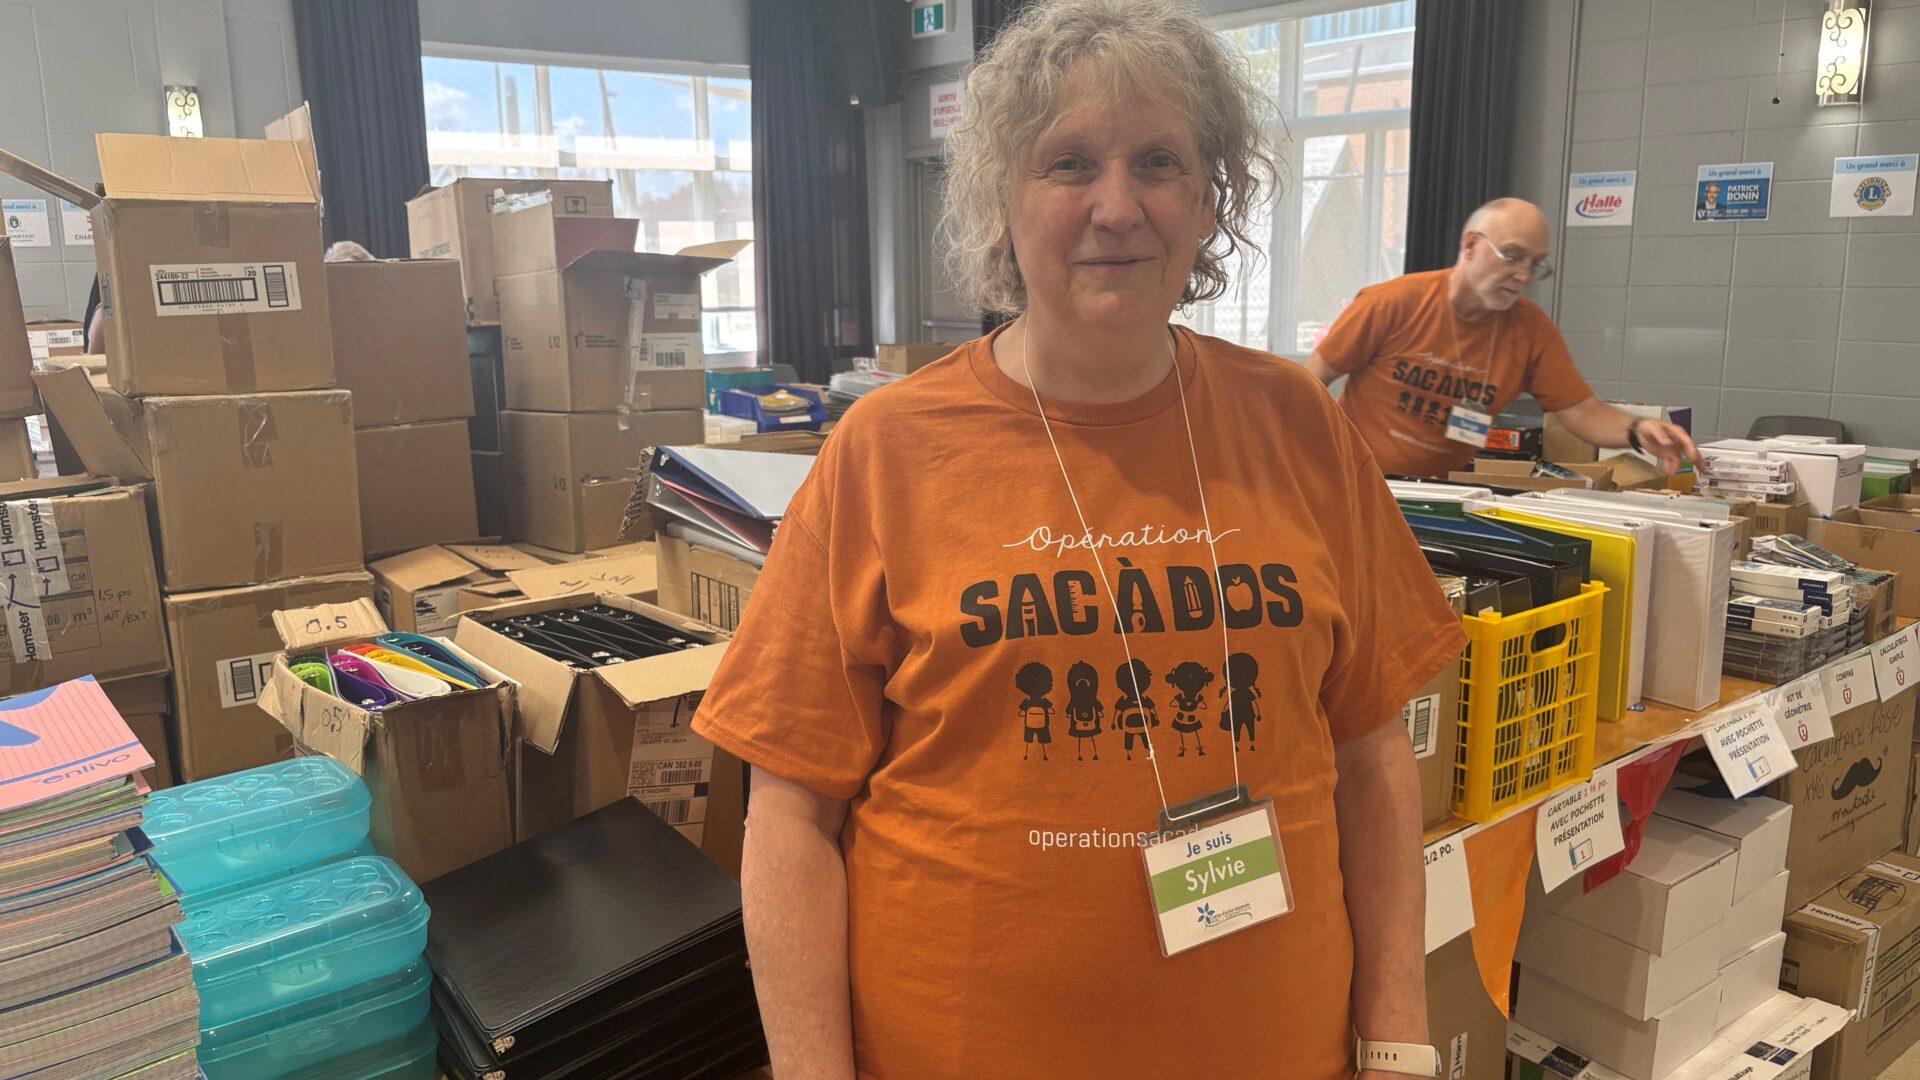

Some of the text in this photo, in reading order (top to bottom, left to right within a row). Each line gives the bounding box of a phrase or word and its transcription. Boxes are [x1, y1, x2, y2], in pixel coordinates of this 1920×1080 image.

[1709, 169, 1717, 177] Un
[1719, 169, 1737, 177] grand
[1738, 168, 1755, 176] merci
[1857, 161, 1879, 170] grand
[1880, 160, 1899, 168] merci
[1588, 176, 1605, 186] grand
[1606, 176, 1620, 184] merci
[1728, 184, 1759, 192] PATRICK
[1582, 192, 1622, 212] Hallé
[1727, 192, 1759, 201] BONIN
[1869, 186, 1878, 200] L
[1392, 360, 1437, 391] SAC
[1454, 377, 1497, 406] DOS
[0, 502, 14, 545] Hamst
[1002, 524, 1240, 558] Opération
[960, 556, 1304, 649] SAC À DOS
[306, 615, 348, 635] 0.5
[19, 611, 37, 663] Hamster
[1880, 635, 1908, 656] CALCULATRICE
[1889, 651, 1904, 665] SIMPLE
[1836, 669, 1854, 682] COMPAS
[1786, 690, 1803, 704] KIT DE
[1784, 702, 1812, 720] GÉOMÉTRIE
[1720, 718, 1765, 748] AVEC POCHETTE
[1728, 733, 1770, 761] PRÉSENTATION
[657, 761, 672, 769] CAN
[641, 787, 671, 795] STANDARD
[1548, 790, 1582, 817] CARTABLE
[1597, 779, 1608, 791] po.
[1550, 793, 1605, 832] AVEC POCHETTE
[1553, 810, 1604, 847] PRÉSENTATION
[1187, 831, 1233, 858] Je suis
[1439, 843, 1454, 858] PO.
[1185, 856, 1246, 894] Sylvie
[1810, 907, 1864, 927] Hamster
